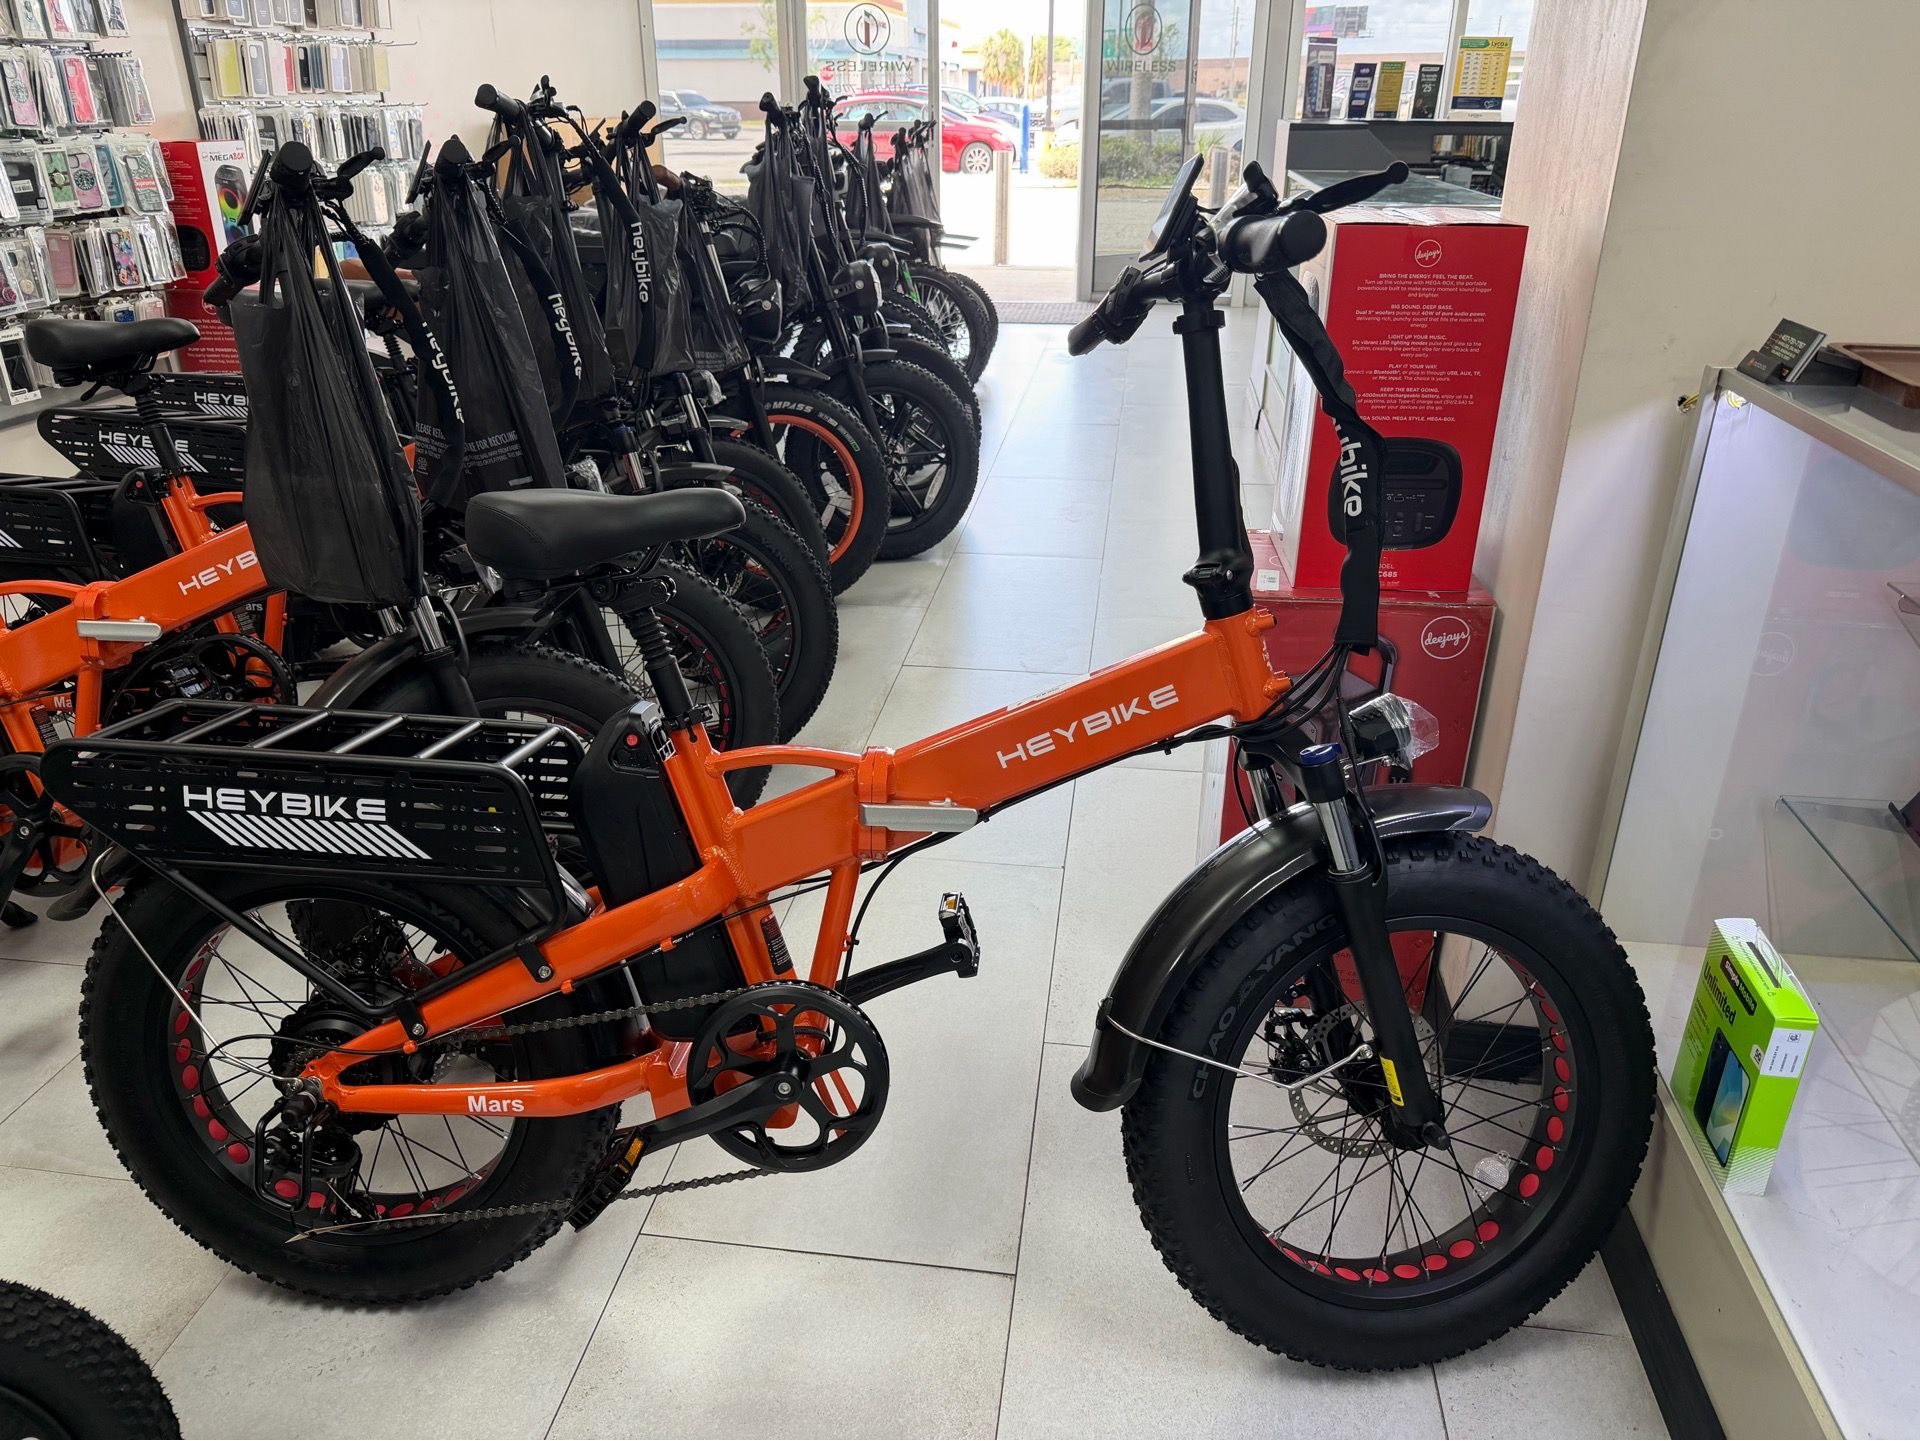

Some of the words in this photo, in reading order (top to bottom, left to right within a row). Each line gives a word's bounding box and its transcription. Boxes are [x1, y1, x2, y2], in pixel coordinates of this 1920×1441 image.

[1106, 60, 1177, 72] WIRELESS
[1416, 249, 1442, 260] deejays
[98, 430, 188, 452] HEYBE
[178, 550, 258, 596] HEYB
[245, 602, 263, 612] ars
[1424, 630, 1470, 648] deejays
[54, 696, 72, 708] Ma
[996, 684, 1179, 768] HEYBIKE
[183, 785, 386, 822] HEYBIKE
[1704, 961, 1737, 1026] Unlimited
[1724, 960, 1740, 988] Simple
[1738, 984, 1756, 1013] Mobile
[468, 1096, 524, 1112] Mars
